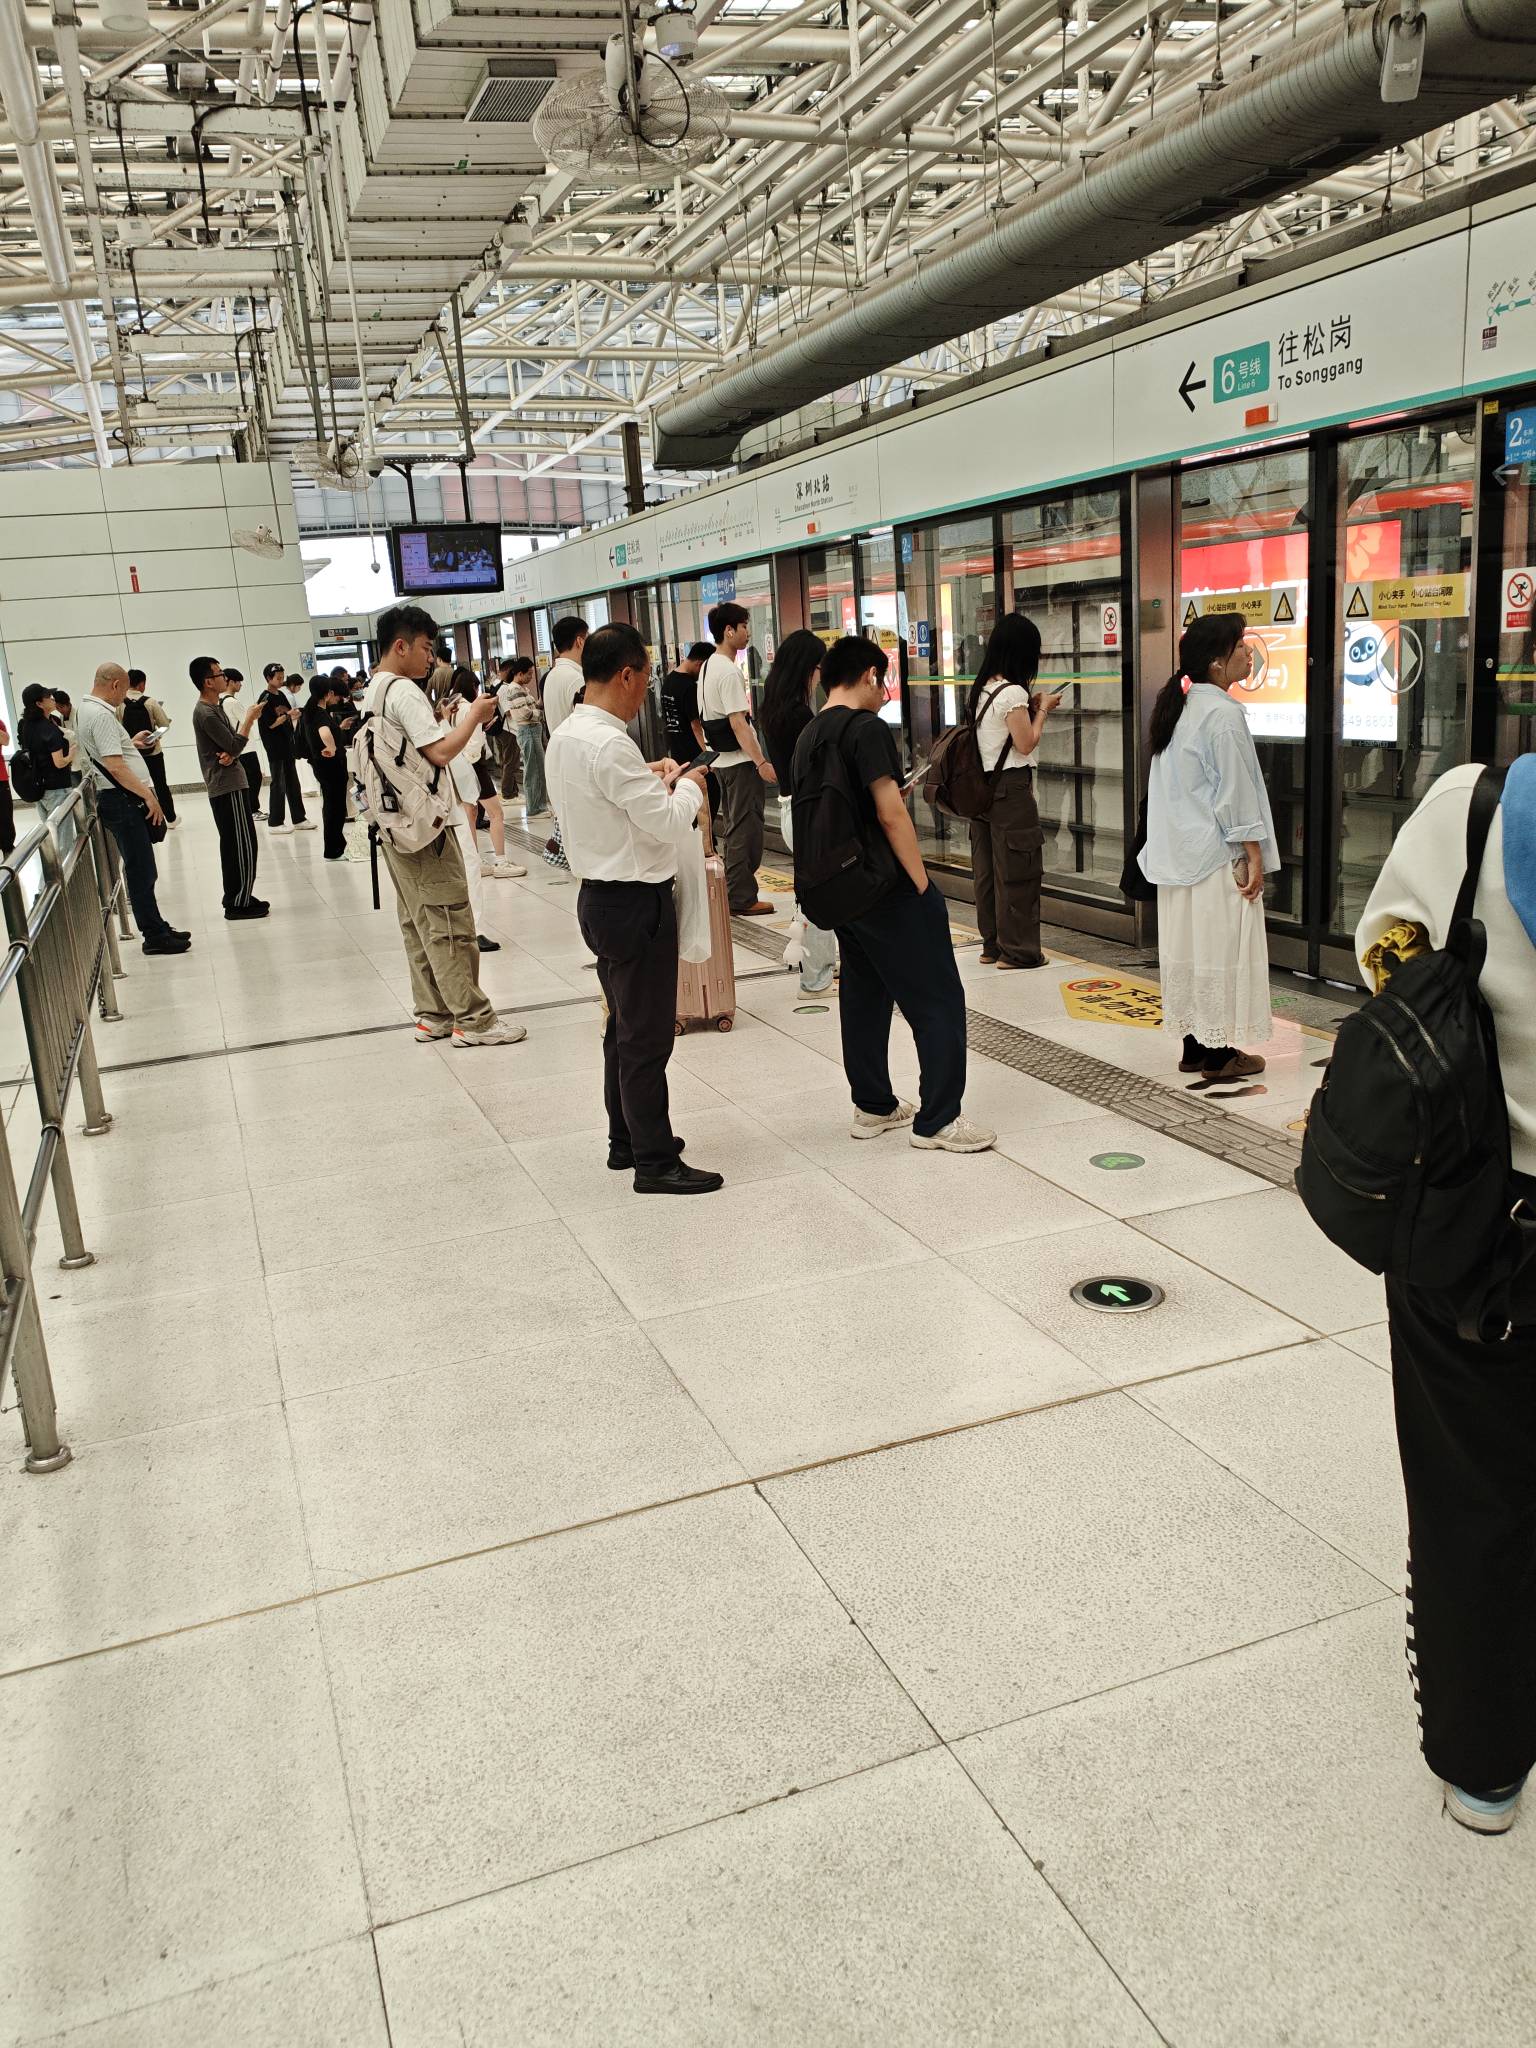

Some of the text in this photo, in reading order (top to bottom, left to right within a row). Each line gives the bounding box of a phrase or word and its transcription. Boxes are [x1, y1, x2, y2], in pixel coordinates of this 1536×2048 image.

[1278, 314, 1351, 367] 往松岗
[1237, 382, 1250, 392] Line
[1278, 357, 1363, 390] To Songgang
[1509, 417, 1523, 447] 2
[796, 473, 830, 500] 深圳北站
[1240, 599, 1263, 610] 小心夹手
[1378, 586, 1453, 601] 小心夹手 小心站台间隙
